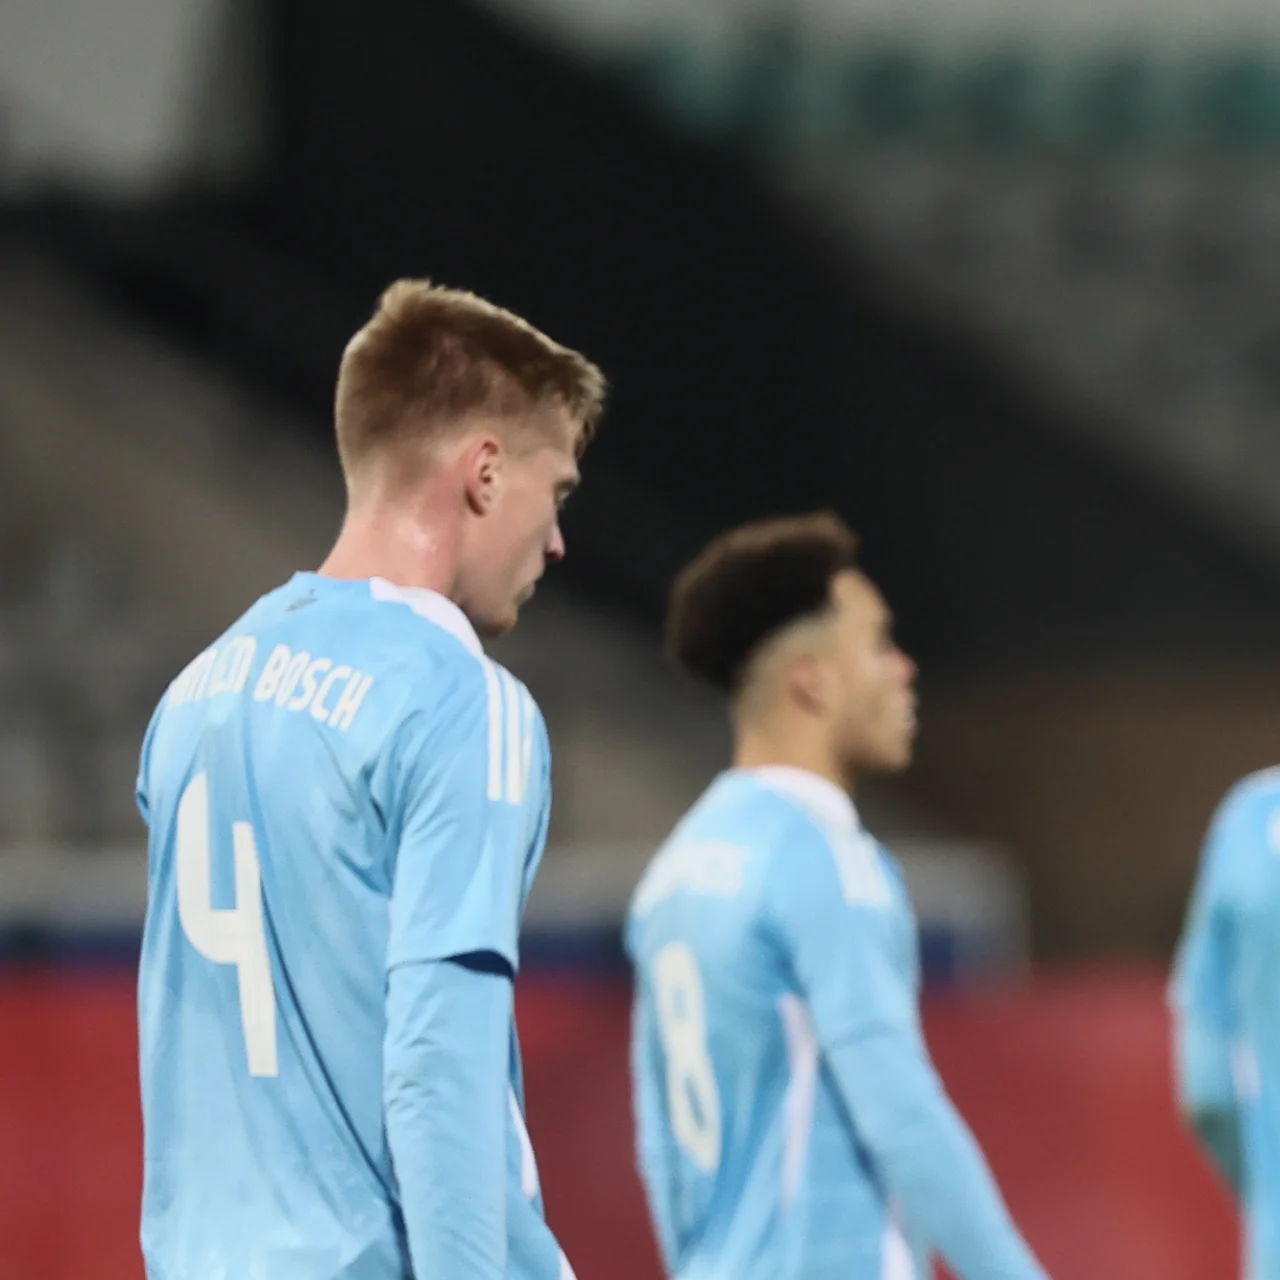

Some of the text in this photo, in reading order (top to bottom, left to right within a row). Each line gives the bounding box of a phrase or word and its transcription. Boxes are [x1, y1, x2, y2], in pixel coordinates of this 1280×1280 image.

[253, 643, 373, 733] BOSCH
[177, 768, 278, 1077] 4
[652, 940, 722, 1175] 8
